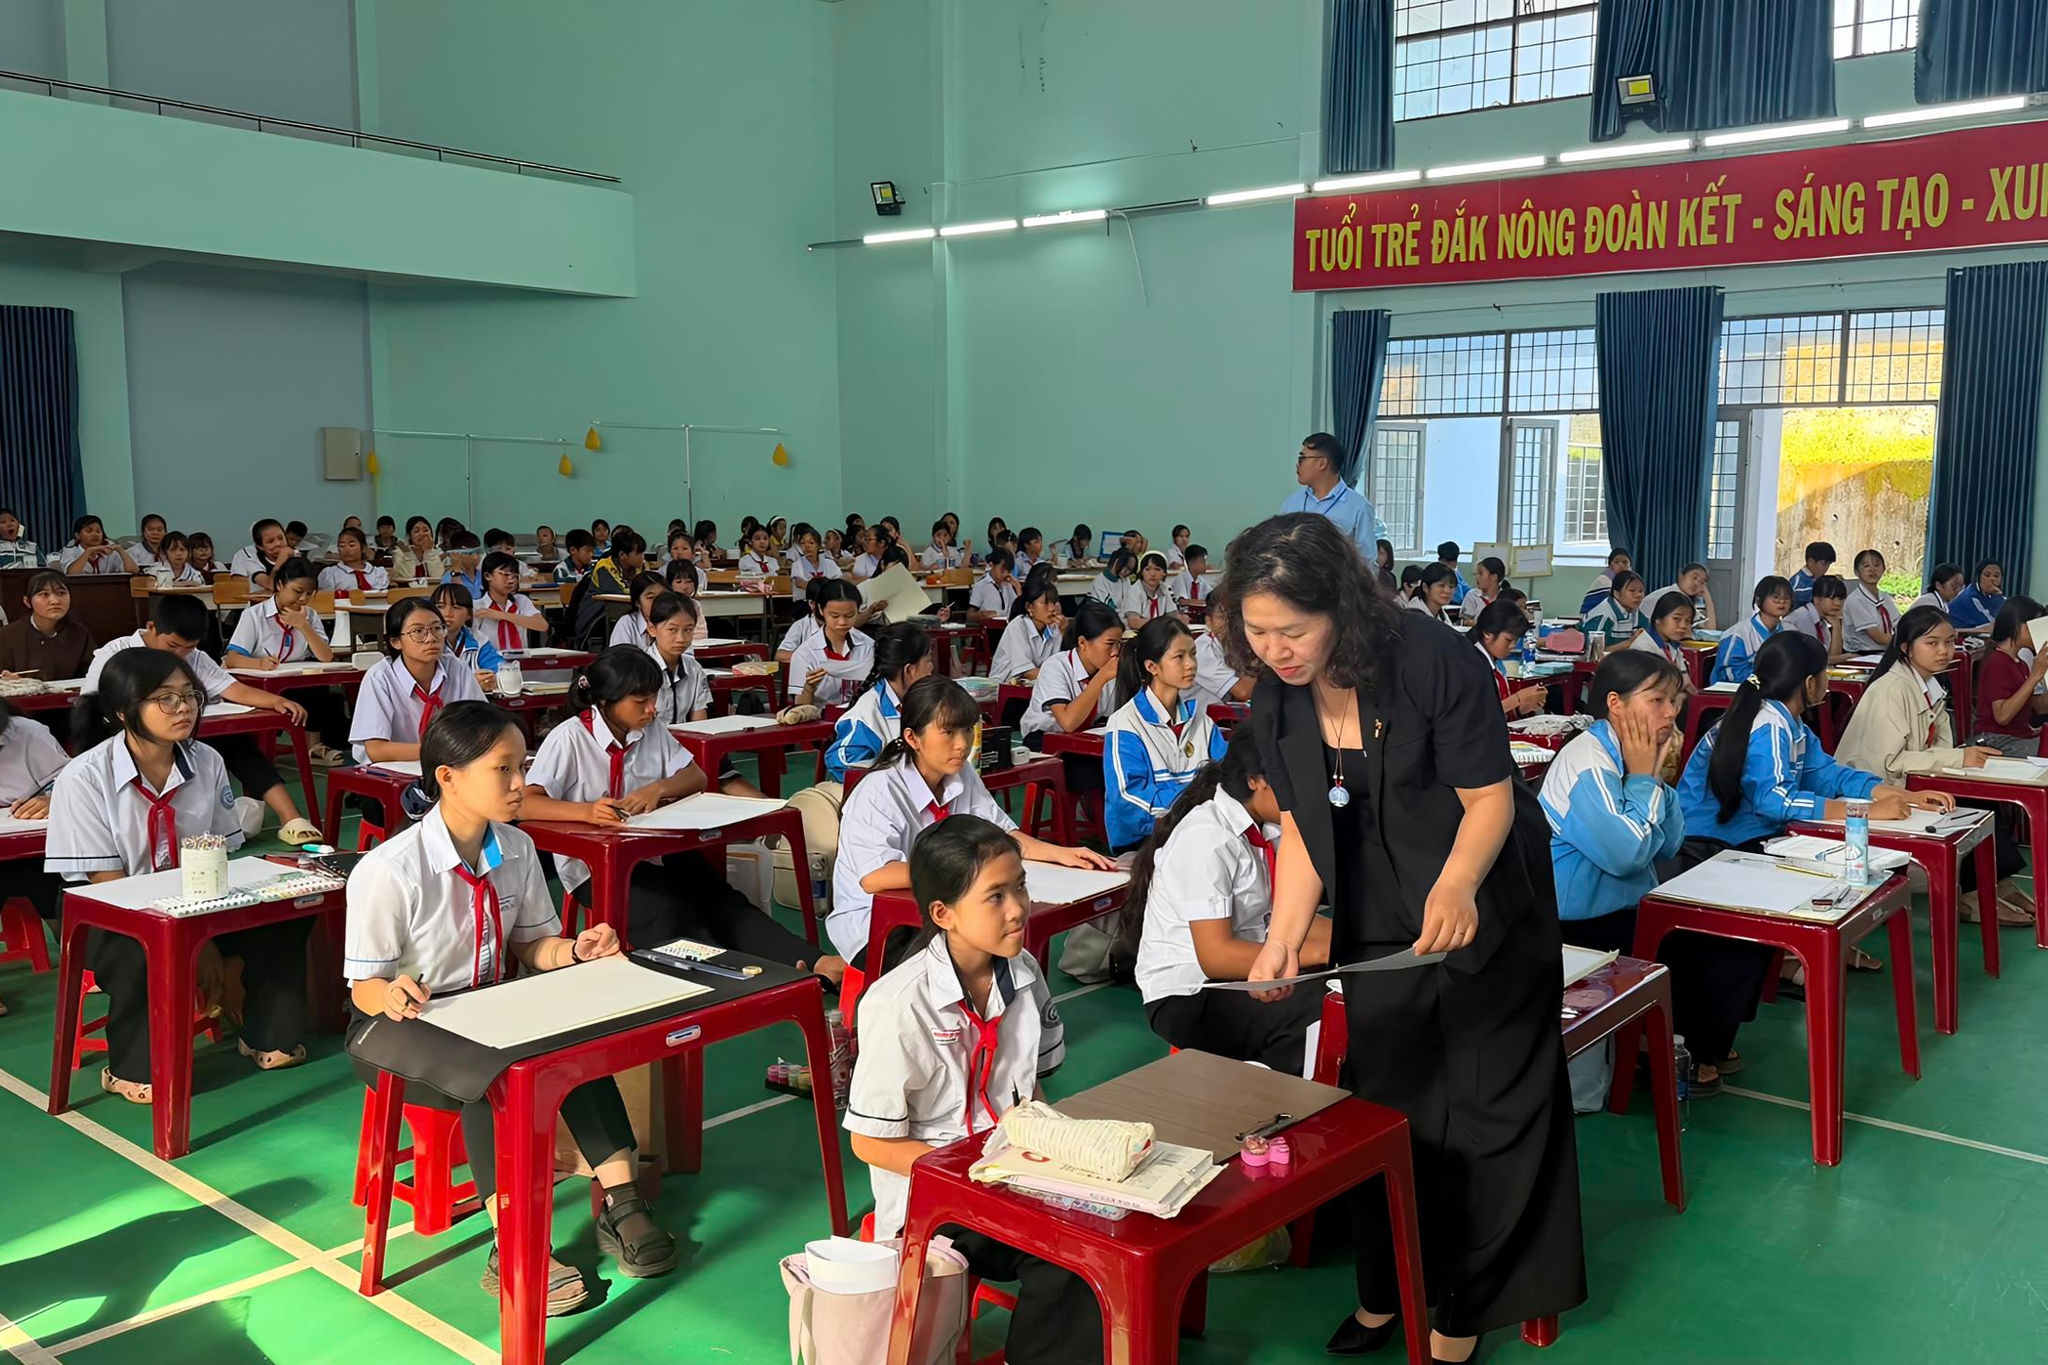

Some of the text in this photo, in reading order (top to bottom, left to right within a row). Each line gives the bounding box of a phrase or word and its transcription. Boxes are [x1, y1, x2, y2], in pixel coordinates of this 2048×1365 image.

[1305, 202, 1363, 272] TUỔI
[1371, 203, 1421, 268] TRẺ
[1431, 199, 1488, 264] ĐẮK
[1497, 198, 1575, 260] NÔNG
[1584, 189, 1668, 254] ĐOÀN
[1678, 174, 1742, 247] KẾT
[1752, 218, 1764, 229] -
[1774, 172, 1866, 241] SÁNG
[1877, 173, 1950, 241] TẠO
[1962, 198, 1975, 210] -
